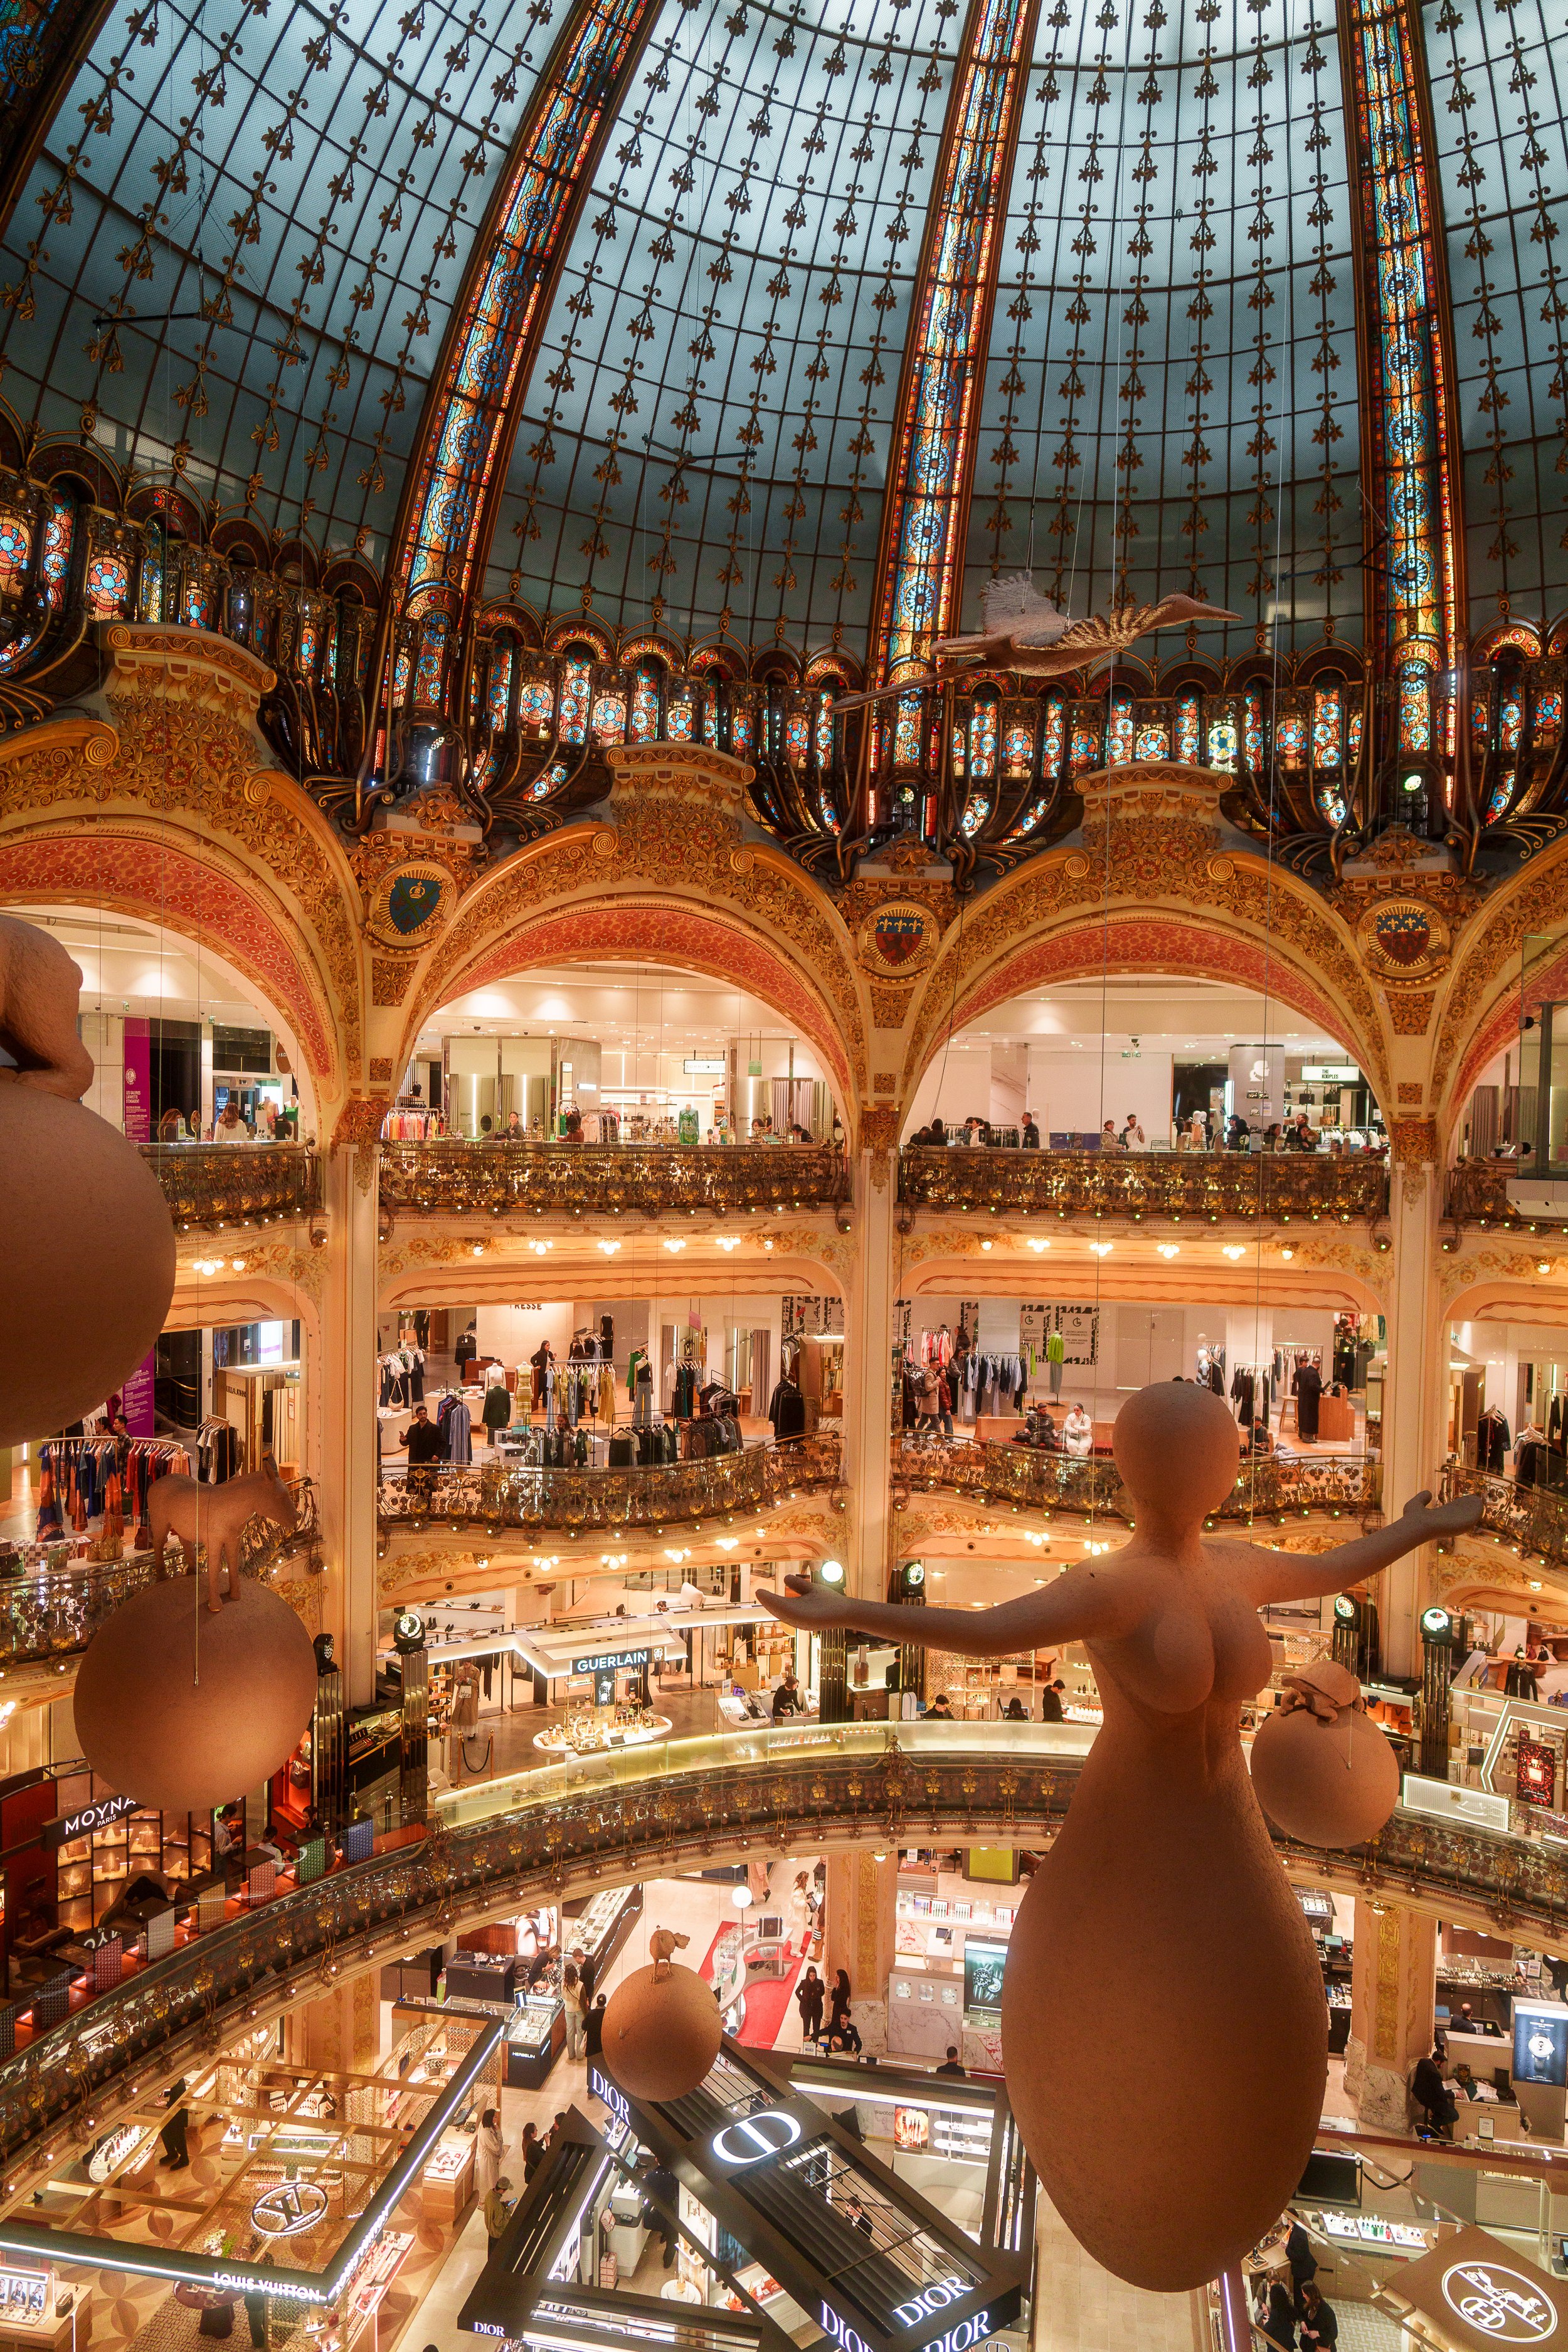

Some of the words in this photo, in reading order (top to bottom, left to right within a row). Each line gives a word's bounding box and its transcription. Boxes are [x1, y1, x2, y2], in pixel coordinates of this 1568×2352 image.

[577, 1651, 647, 1672] GUERLAIN
[97, 1814, 117, 1827] PARIS
[593, 2067, 631, 2126] DIOR
[213, 2271, 255, 2291] LOUIS
[258, 2279, 320, 2302] VUITTON
[892, 2275, 975, 2328] DIOR
[473, 2321, 506, 2337] DIOR
